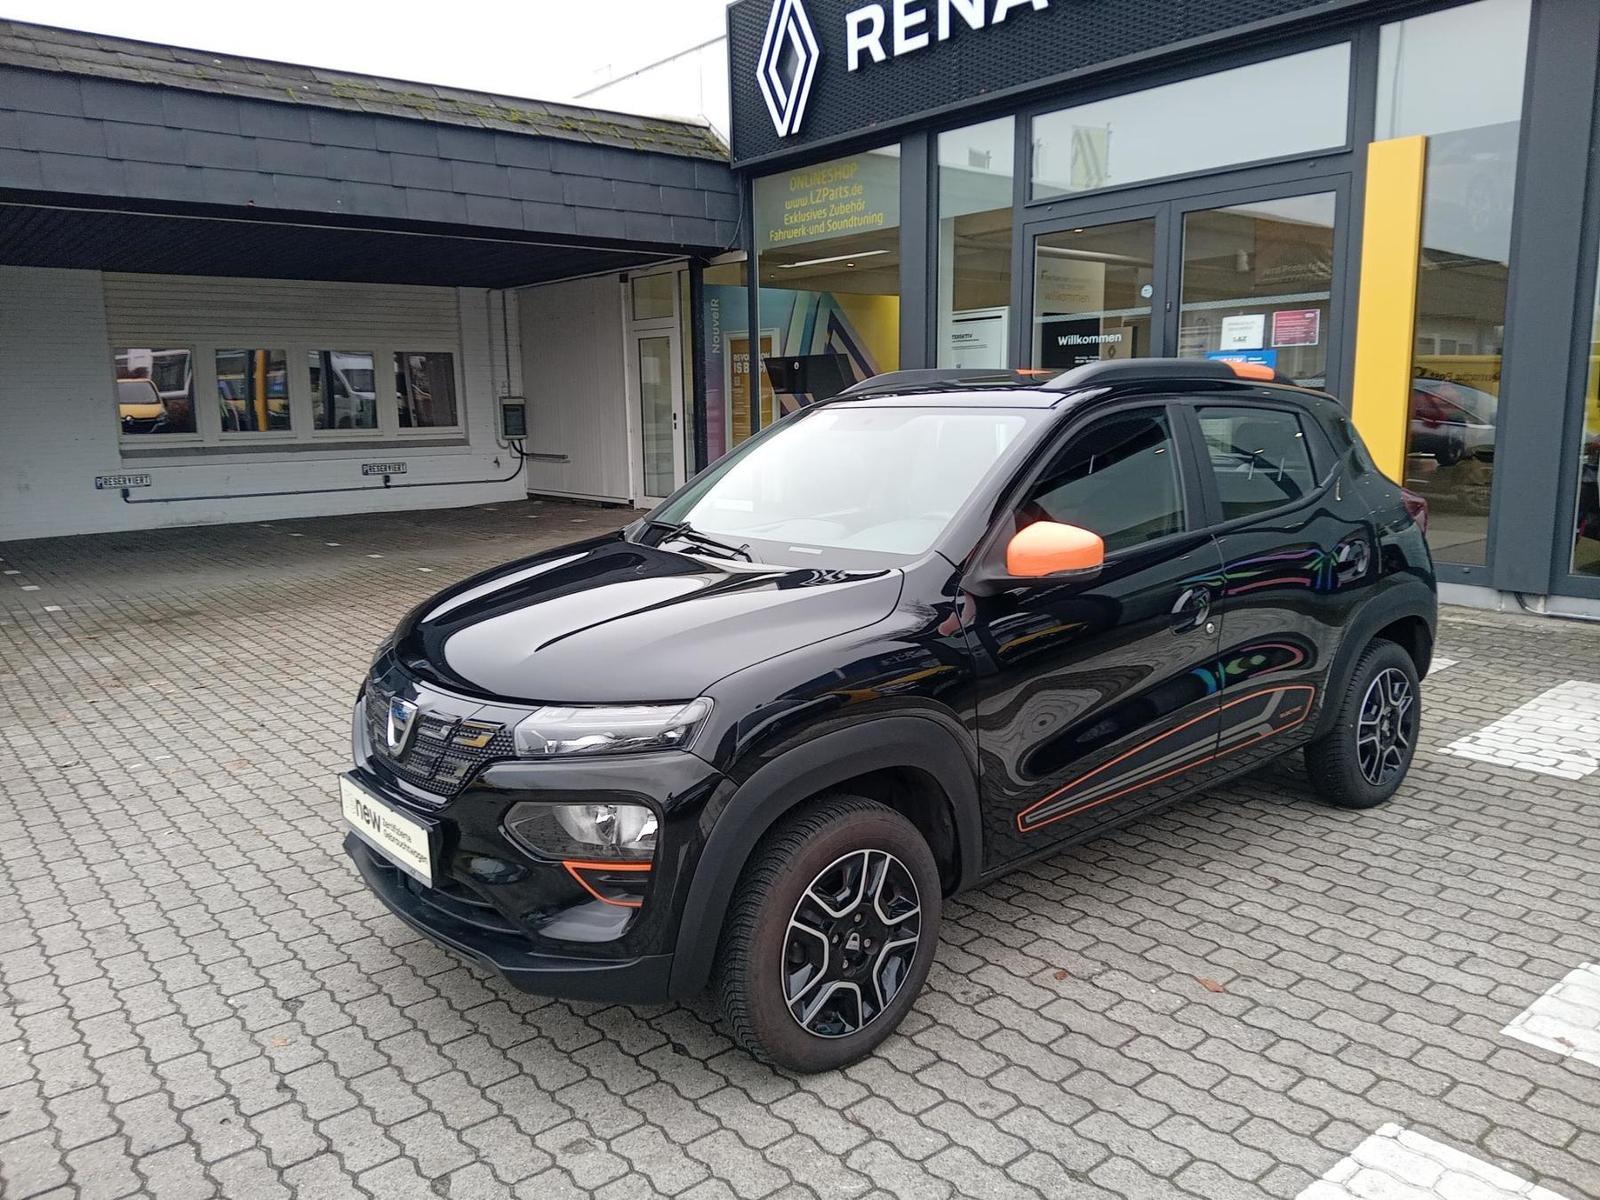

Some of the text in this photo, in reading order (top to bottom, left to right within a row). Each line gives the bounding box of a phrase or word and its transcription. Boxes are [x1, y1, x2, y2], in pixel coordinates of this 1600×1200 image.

[790, 163, 857, 190] ONLINESHOP
[785, 184, 863, 209] www.LZParts.de
[784, 200, 866, 225] Exklusives Zubehör
[826, 212, 884, 233] Soundtuning
[1057, 333, 1122, 346] Willkommen
[103, 475, 149, 486] RESERVIERT
